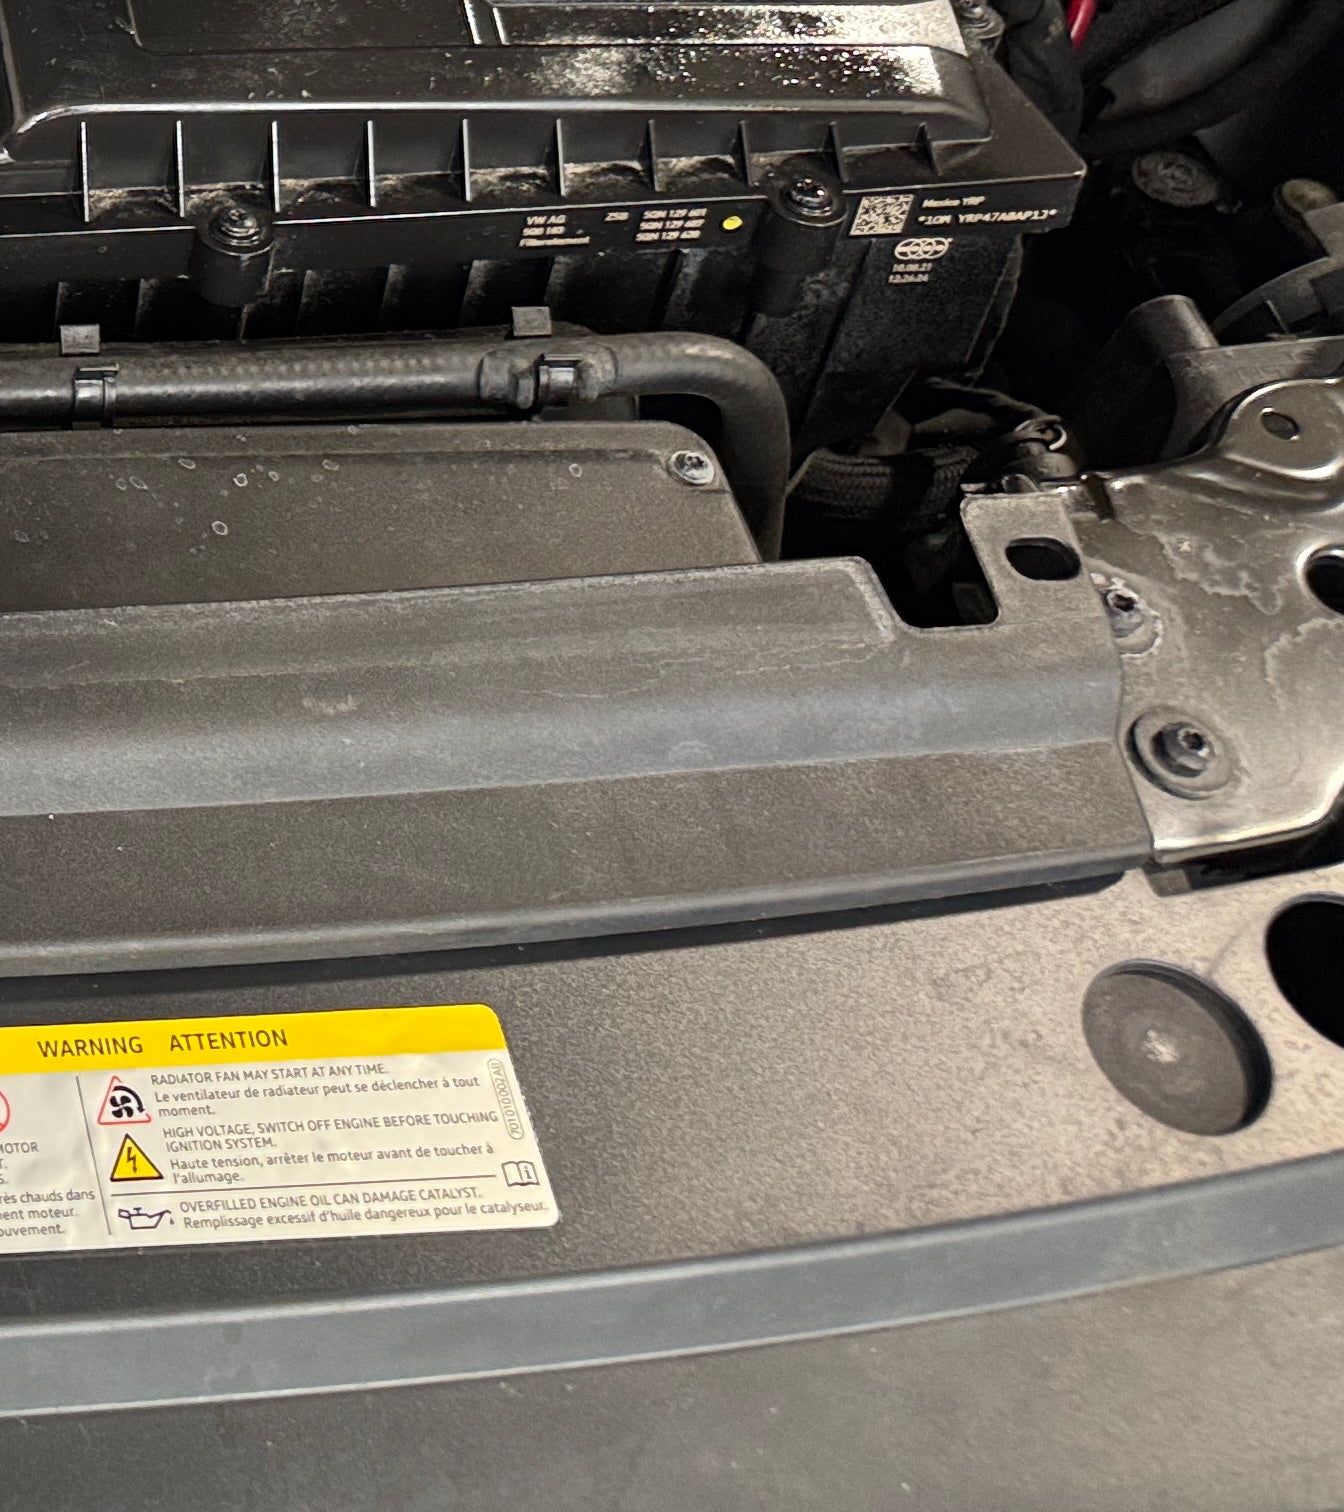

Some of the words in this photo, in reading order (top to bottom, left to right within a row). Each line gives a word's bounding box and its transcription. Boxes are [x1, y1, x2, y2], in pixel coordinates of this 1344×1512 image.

[37, 1037, 144, 1057] WARNING
[168, 1028, 288, 1052] ATTENTION
[151, 1073, 215, 1086] RADIATOR
[216, 1071, 241, 1083] FAN
[243, 1068, 270, 1082] MAY
[271, 1067, 308, 1080] START
[311, 1066, 326, 1078] AT
[328, 1064, 353, 1077] ANY
[154, 1089, 171, 1103] Le
[172, 1087, 243, 1102] ventilateur
[245, 1086, 261, 1099] de
[263, 1083, 320, 1098] radiateur
[322, 1082, 352, 1097] peut
[354, 1081, 369, 1093] se
[370, 1077, 440, 1092] déclencher
[442, 1076, 451, 1089] à
[452, 1076, 481, 1088] tout
[158, 1104, 216, 1118] moment.
[163, 1125, 195, 1138] HIGH
[197, 1122, 255, 1138] VOLTAGE,
[257, 1120, 305, 1134] SWITCH
[308, 1118, 333, 1131] OFF
[335, 1116, 382, 1130] ENGINE
[384, 1114, 432, 1128] BEFORE
[433, 1111, 498, 1126] TOUCHING
[166, 1138, 223, 1153] IGNITION
[226, 1135, 277, 1150] SYSTEM.
[170, 1157, 210, 1171] Haute
[212, 1154, 264, 1169] tension,
[313, 1150, 325, 1163] le
[327, 1148, 374, 1162] moteur
[376, 1146, 413, 1160] avant
[415, 1144, 432, 1158] de
[435, 1142, 484, 1156] toucher
[19, 1191, 64, 1204] chauds
[66, 1189, 96, 1202] dans
[179, 1197, 257, 1212] OVERFILLED
[260, 1195, 307, 1209] ENGINE
[309, 1193, 331, 1207] OIL
[333, 1192, 360, 1205] CAN
[362, 1189, 417, 1204] DAMAGE
[419, 1186, 483, 1202] CATALYST.
[28, 1206, 80, 1220] moteur.
[184, 1214, 265, 1230] Remplissage
[267, 1210, 316, 1225] excessif
[318, 1208, 362, 1222] d'huile
[365, 1206, 431, 1222] dangereux
[433, 1204, 464, 1219] pour
[466, 1203, 478, 1215] le
